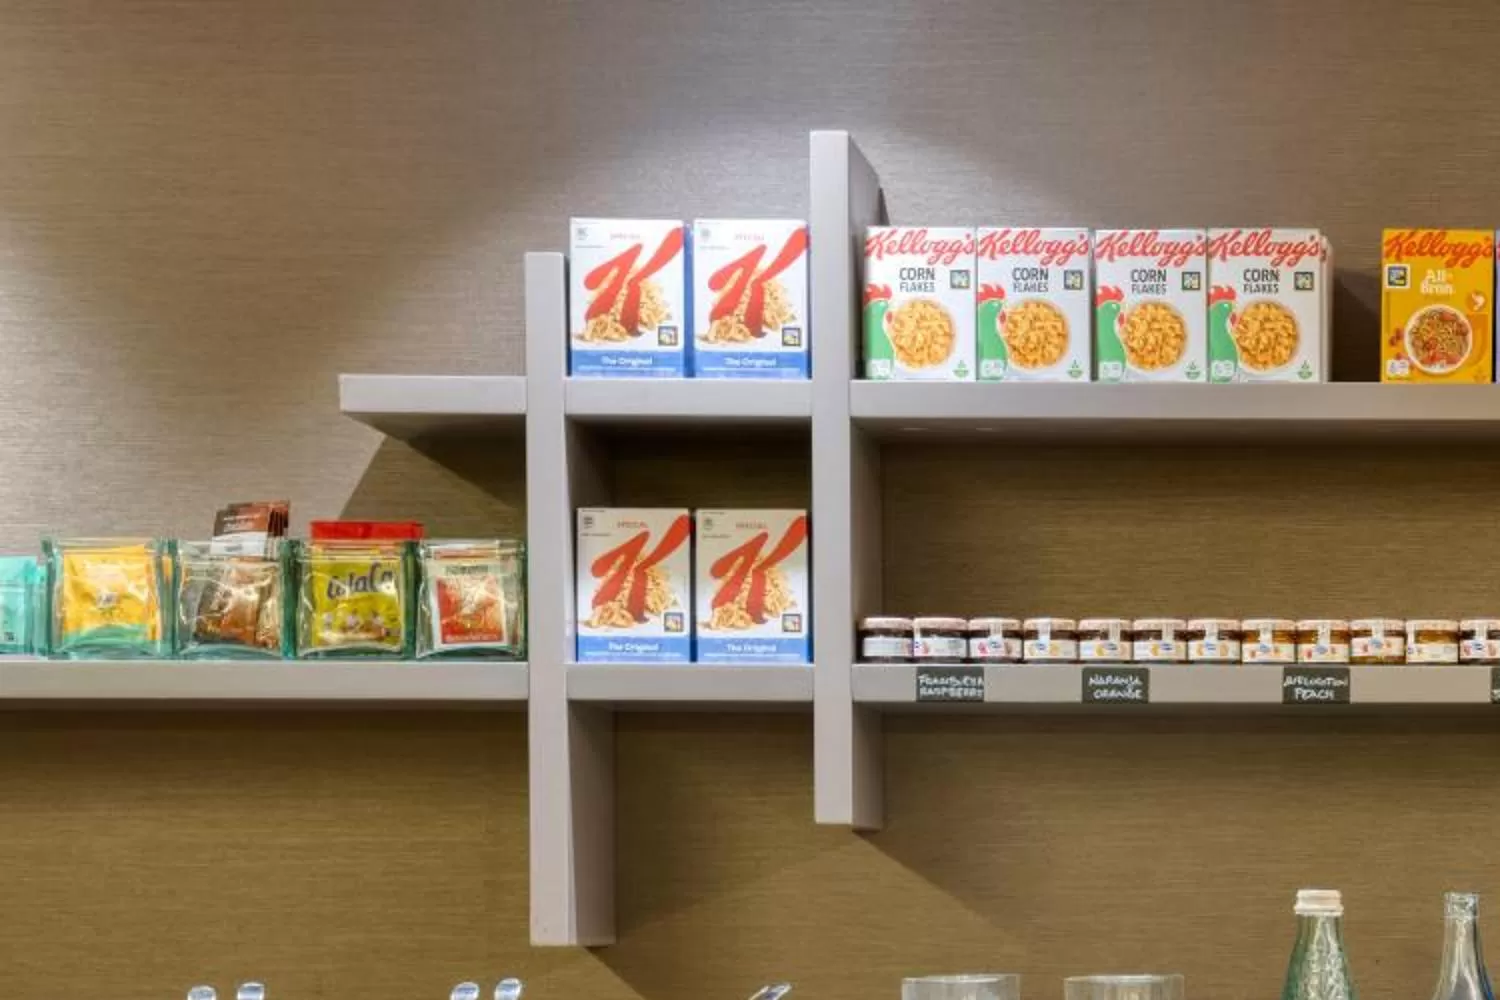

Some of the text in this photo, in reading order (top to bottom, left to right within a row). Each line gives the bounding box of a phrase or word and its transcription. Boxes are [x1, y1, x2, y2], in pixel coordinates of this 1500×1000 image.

[865, 227, 976, 265] Kellogg's
[977, 227, 1089, 266] Kellogg's
[1096, 228, 1207, 267] Kellogg's
[1208, 226, 1320, 268] Kellogg's
[1384, 228, 1493, 268] Kellogg's
[900, 268, 935, 281] CORN
[1012, 268, 1049, 281] CORN
[1131, 269, 1167, 282] CORN
[1243, 269, 1279, 282] CORN
[900, 282, 935, 292] FLAKES
[1012, 282, 1049, 292] FLAKES
[1131, 283, 1167, 294] FLAKES
[1243, 283, 1279, 293] FLAKES
[1093, 687, 1143, 699] ORANGE
